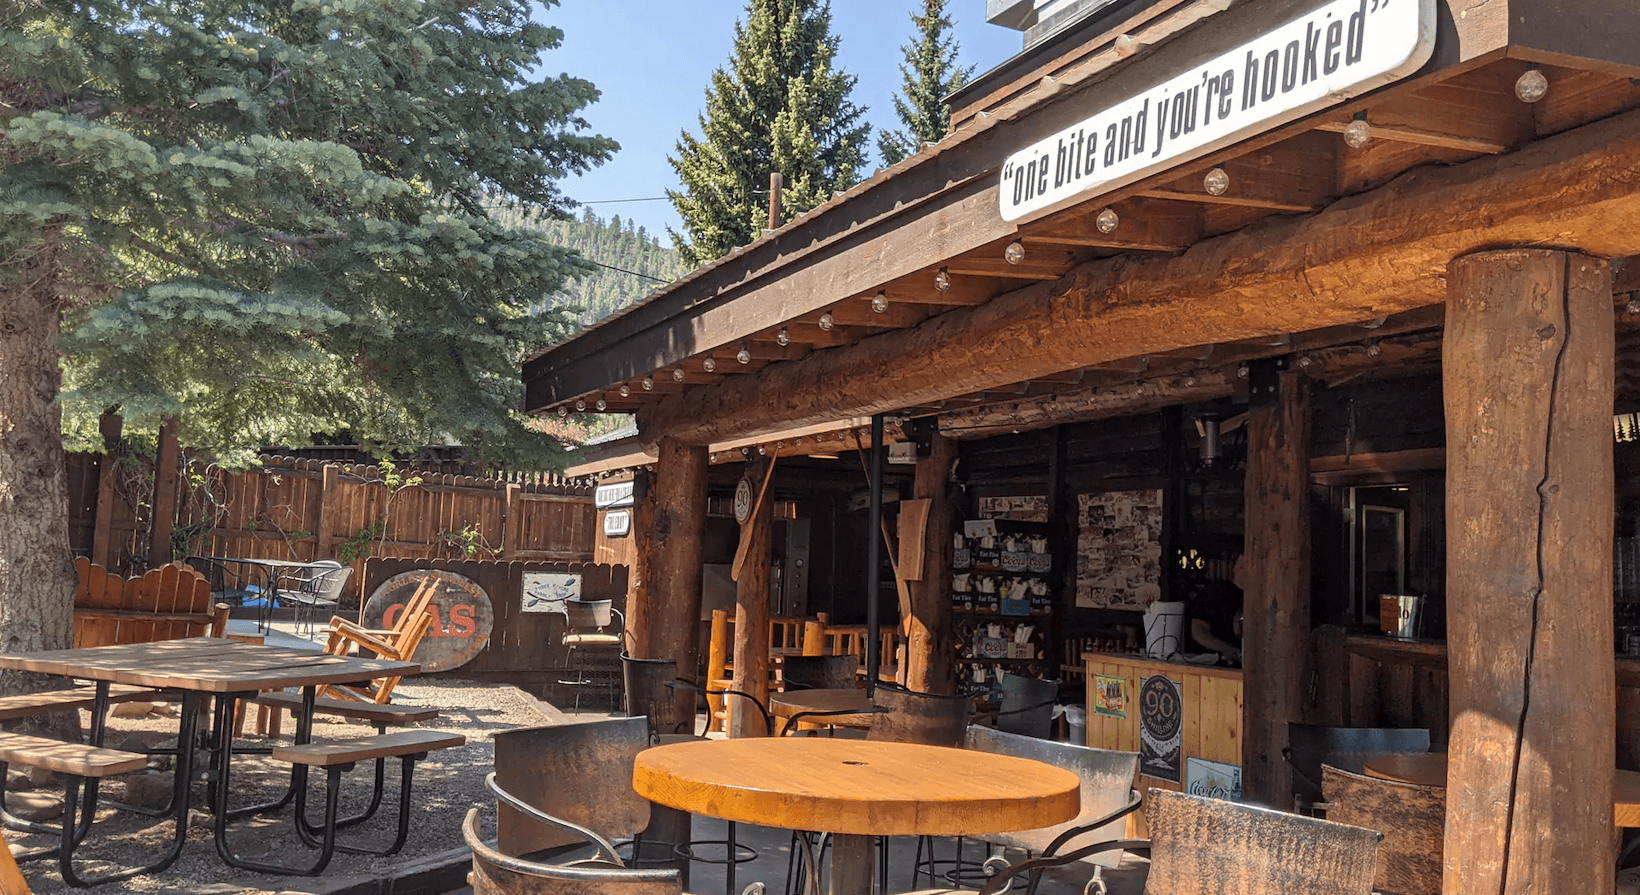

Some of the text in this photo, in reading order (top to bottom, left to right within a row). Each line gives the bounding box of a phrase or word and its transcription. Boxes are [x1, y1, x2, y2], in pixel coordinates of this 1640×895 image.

[1004, 150, 1049, 206] "one
[1054, 128, 1096, 189] bite
[1104, 99, 1148, 168] and
[1151, 68, 1235, 158] you're
[737, 490, 748, 507] 90
[1002, 554, 1026, 566] Coors
[1028, 556, 1050, 568] Coors
[985, 641, 1007, 652] Coors
[1145, 690, 1174, 718] 90
